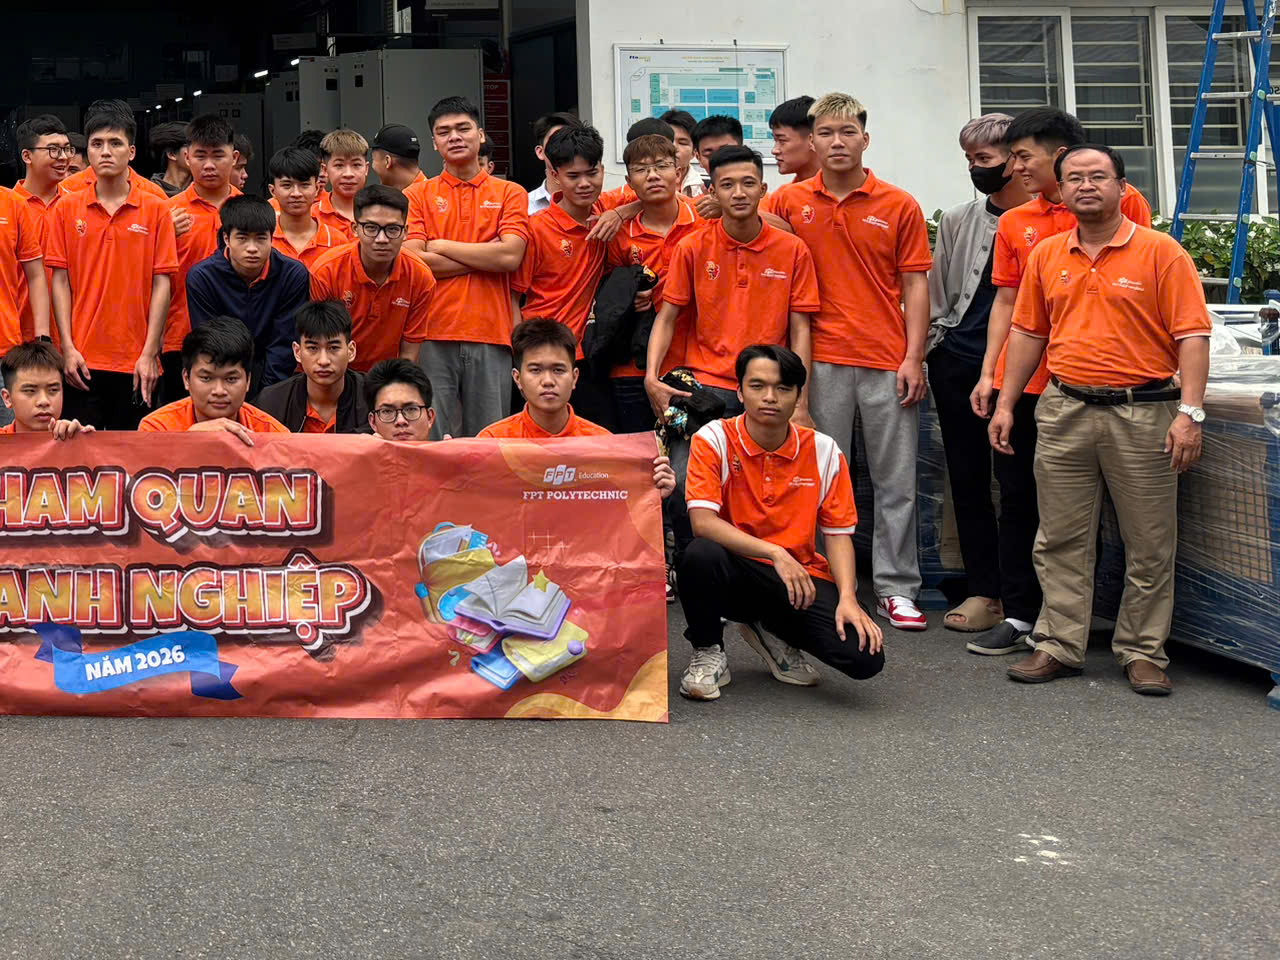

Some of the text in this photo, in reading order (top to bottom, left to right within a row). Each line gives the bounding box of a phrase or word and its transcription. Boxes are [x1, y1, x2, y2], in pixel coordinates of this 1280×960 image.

[543, 464, 609, 486] FPT Education
[129, 470, 319, 540] QUAN
[523, 490, 629, 500] FPT POLYTECHNIC
[127, 551, 367, 646] NGHIỆP
[84, 644, 186, 681] NĂM 2026
